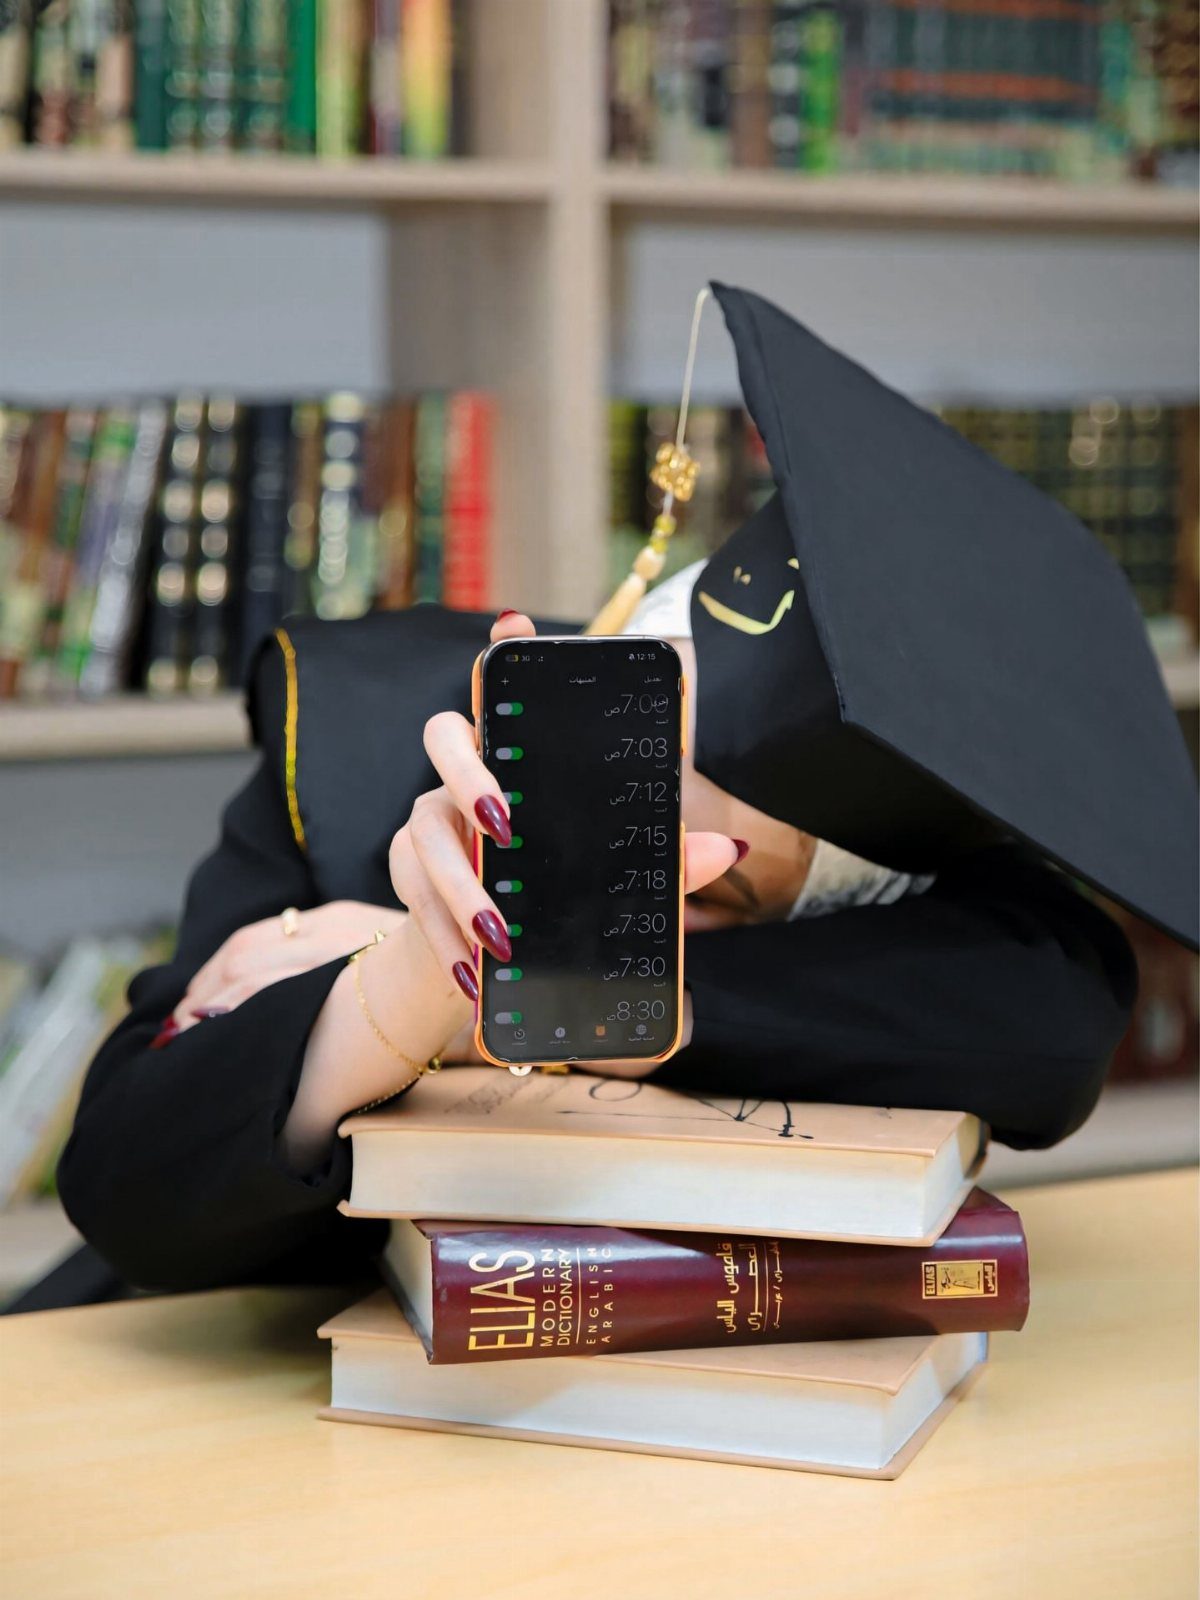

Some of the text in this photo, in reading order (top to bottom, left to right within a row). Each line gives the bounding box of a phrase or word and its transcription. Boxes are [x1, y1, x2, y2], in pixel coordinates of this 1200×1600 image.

[467, 1249, 536, 1351] ELIAS
[540, 1248, 556, 1347] MODERN
[557, 1247, 574, 1346] DICTIONARY
[586, 1247, 599, 1345] ENGLISH
[601, 1247, 614, 1344] ARABIC
[716, 1242, 739, 1295] قاموس
[924, 1264, 935, 1296] ELIAS
